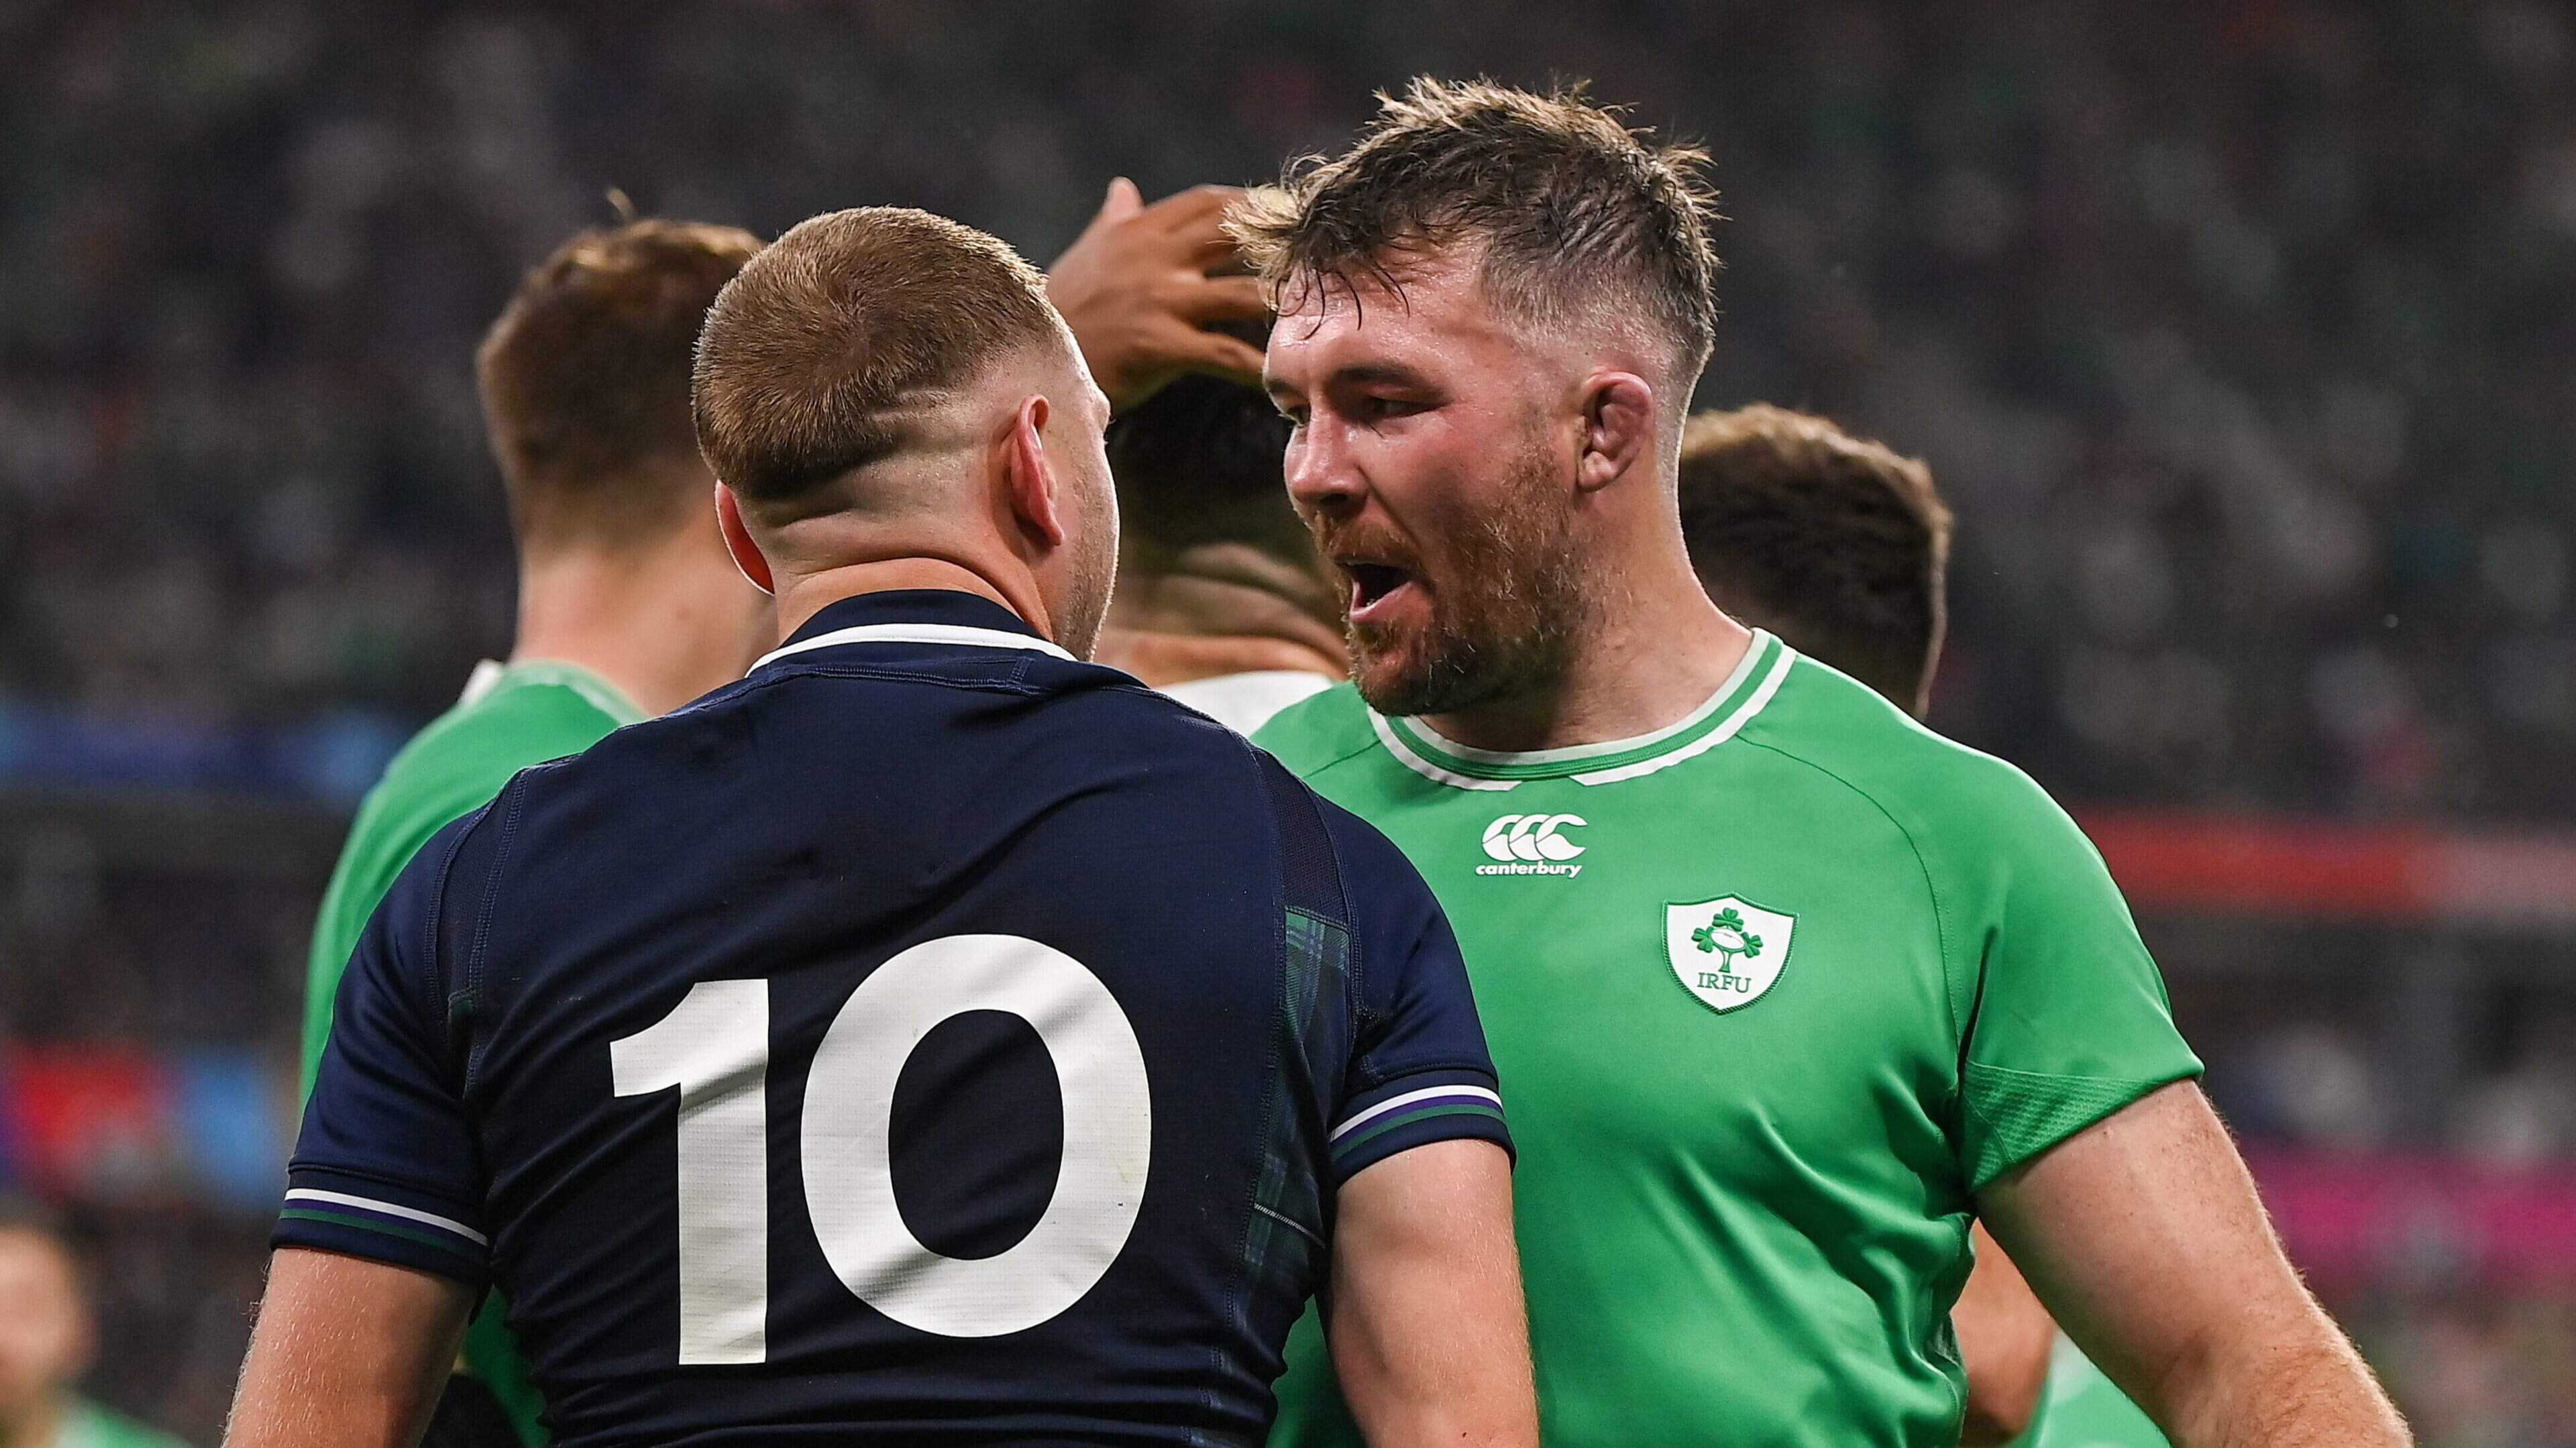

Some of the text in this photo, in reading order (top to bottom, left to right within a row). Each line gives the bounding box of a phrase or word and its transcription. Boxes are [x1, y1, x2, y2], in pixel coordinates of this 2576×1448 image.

[1476, 860, 1582, 878] canterbury
[1697, 972, 1752, 993] IRFU
[610, 934, 1152, 1365] 10
